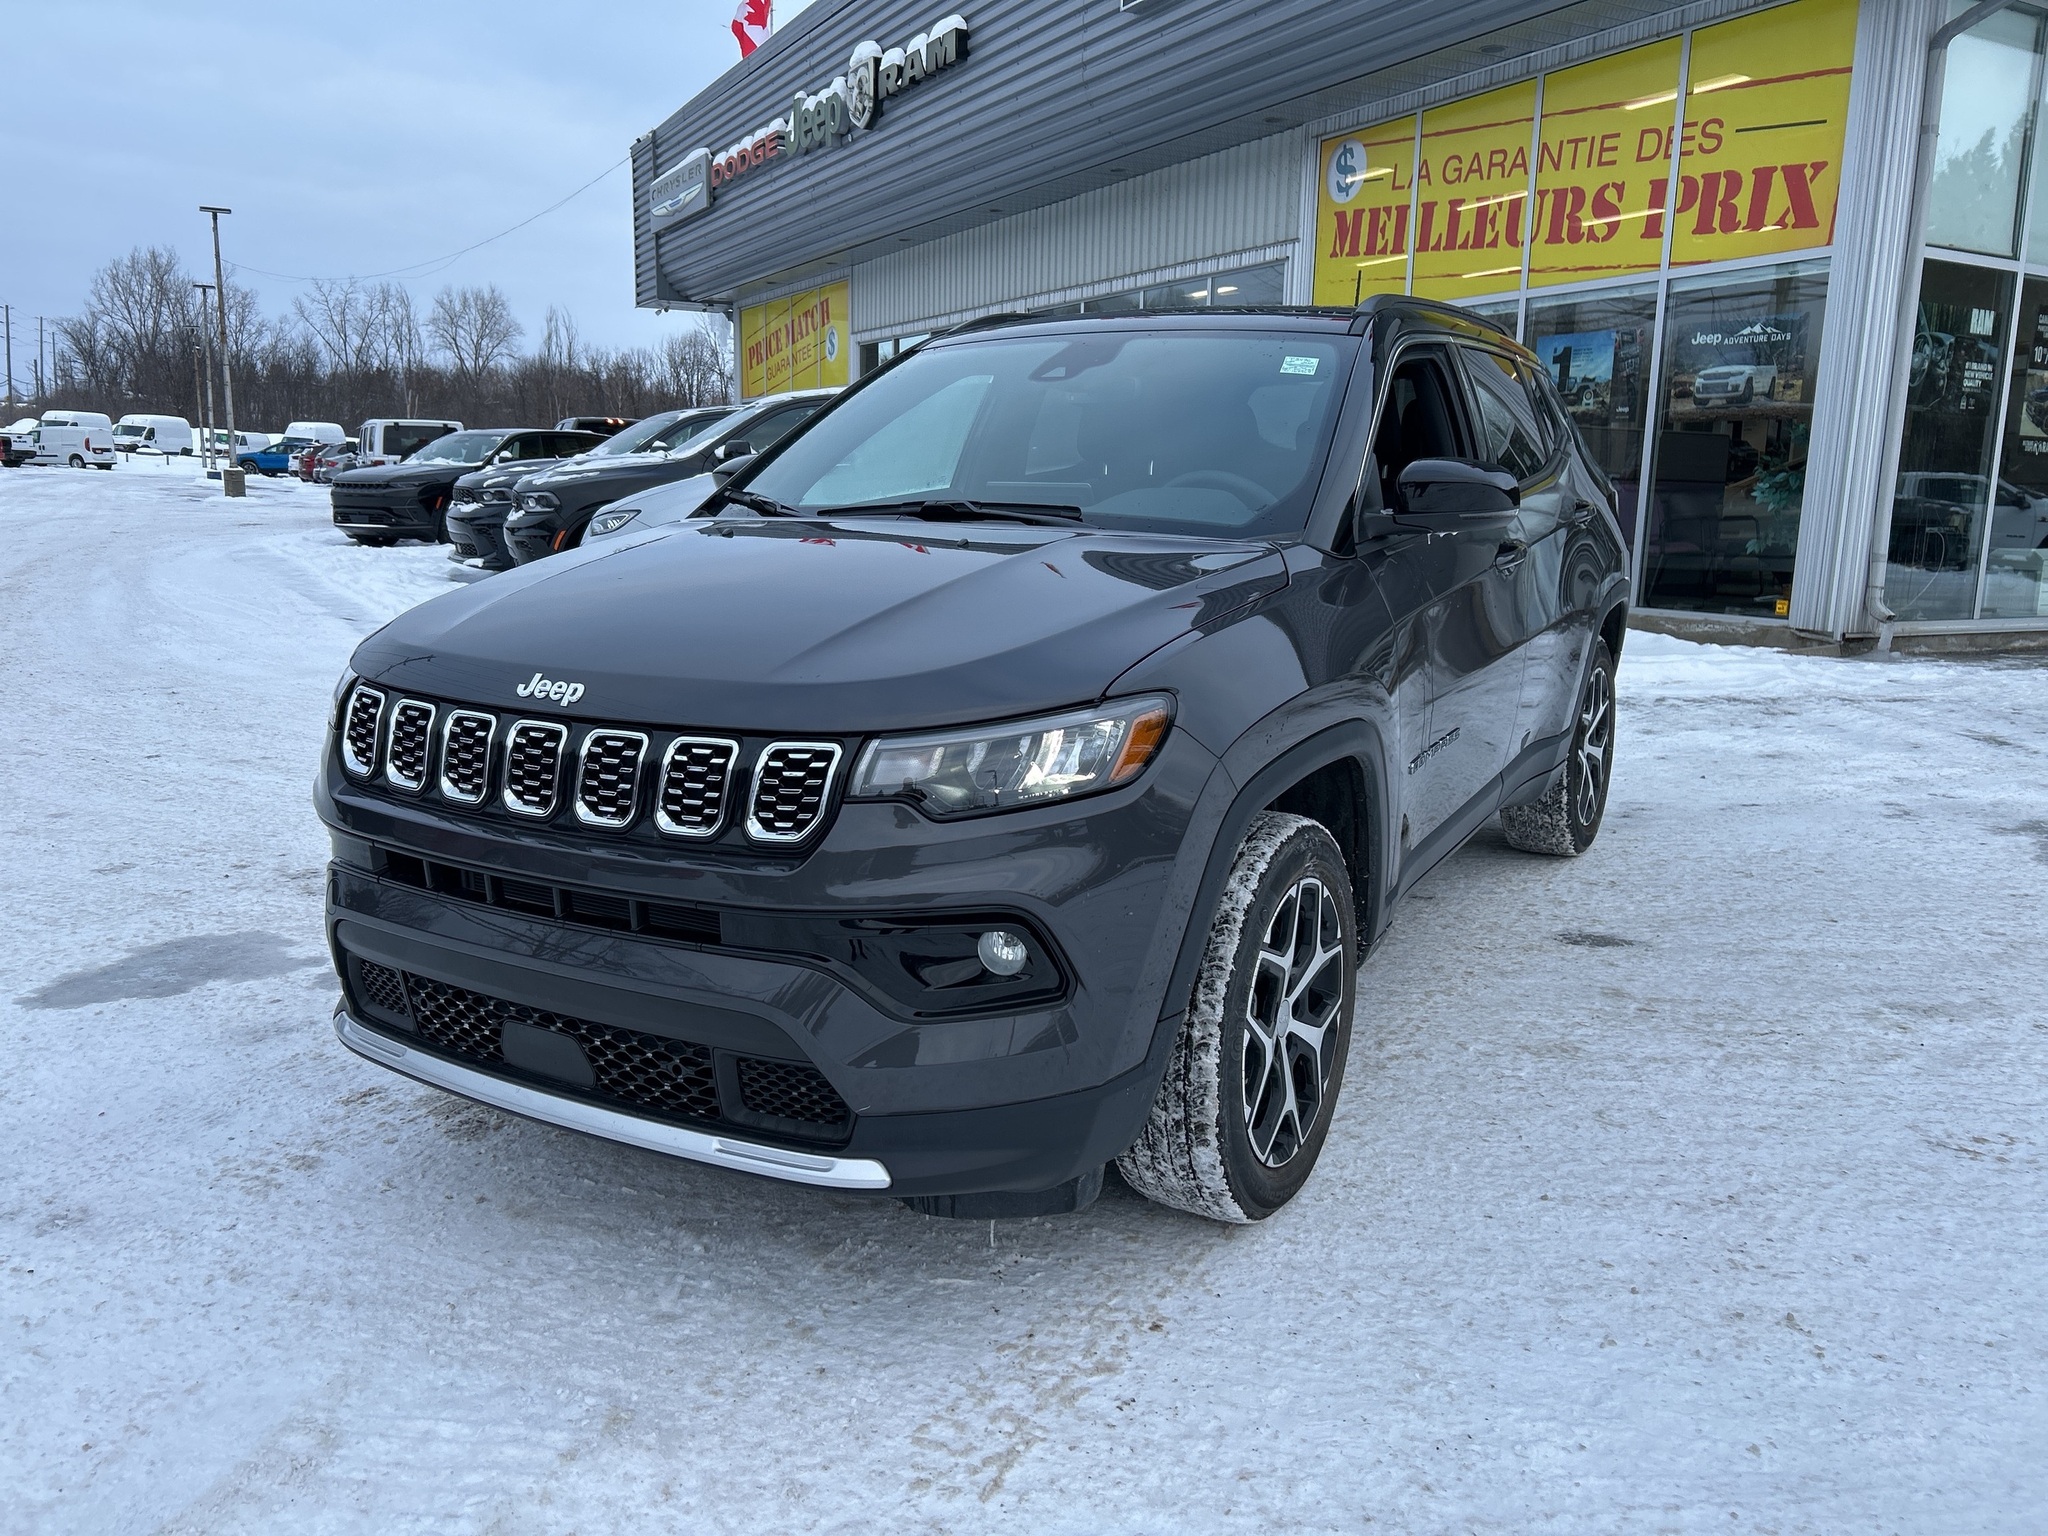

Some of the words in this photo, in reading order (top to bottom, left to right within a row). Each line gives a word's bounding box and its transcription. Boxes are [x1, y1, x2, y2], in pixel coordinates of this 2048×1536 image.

[879, 27, 958, 100] RAM
[785, 91, 843, 156] Jeep
[711, 130, 780, 187] DODGE
[1391, 159, 1432, 191] LA
[1442, 132, 1621, 185] GARANTIE
[1636, 117, 1725, 163] DES
[651, 163, 702, 201] CHRYSLER
[1329, 180, 1626, 258] MEILLEURS
[1640, 160, 1828, 240] PRIX
[748, 327, 783, 371] PRICE
[784, 297, 831, 349] MATCH
[1692, 332, 1722, 345] Jeep
[1723, 334, 1768, 345] ADVENTURE
[1770, 332, 1791, 341] DAYS
[1969, 308, 1995, 336] RAM
[766, 343, 812, 381] GUARANTEE
[1963, 379, 1982, 388] QUALITY
[516, 672, 585, 707] Jeep
